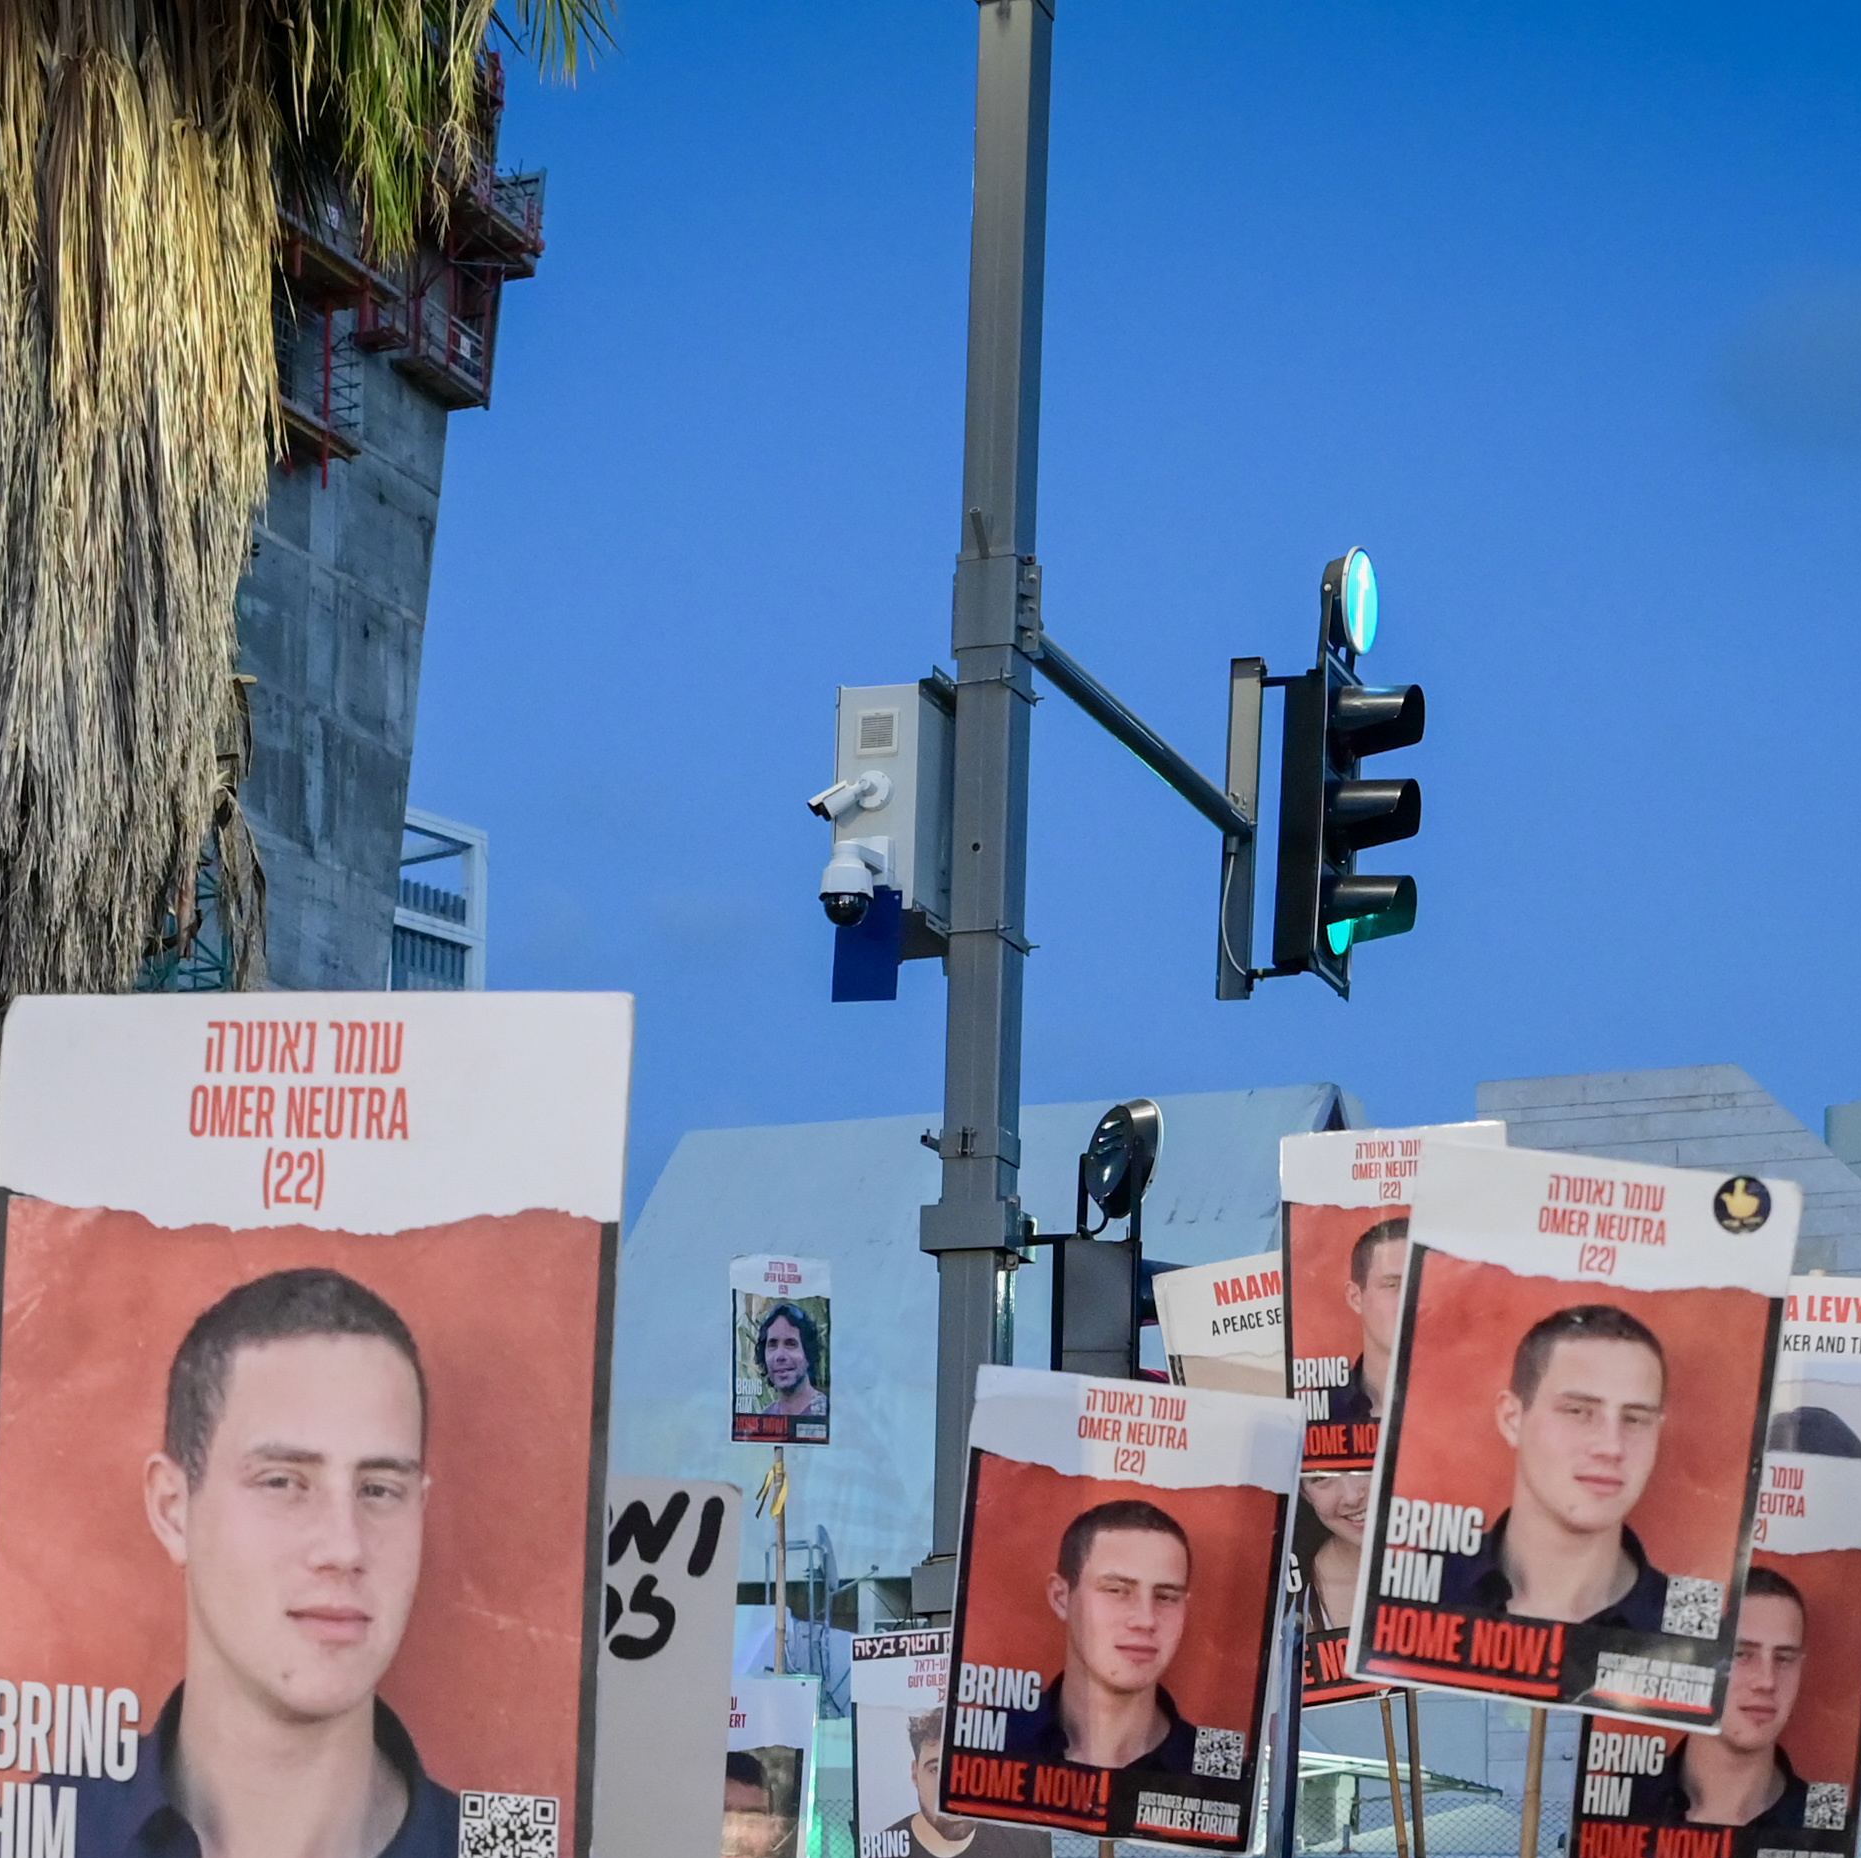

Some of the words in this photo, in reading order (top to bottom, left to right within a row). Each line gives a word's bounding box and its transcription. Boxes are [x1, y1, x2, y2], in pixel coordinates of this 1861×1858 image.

[204, 1020, 315, 1074] נאוטרה
[329, 1020, 403, 1074] עומר
[189, 1084, 273, 1138] OMER
[286, 1086, 409, 1140] NEUTRA
[263, 1148, 324, 1210] (22)
[1352, 1162, 1381, 1180] OMER
[1379, 1181, 1402, 1200] (22)
[1620, 1183, 1665, 1212] עומר
[1538, 1205, 1590, 1237] OMER
[1595, 1211, 1666, 1246] NEUTRA
[1578, 1243, 1616, 1274] (22)
[1225, 1310, 1263, 1333] PEACE
[1813, 1336, 1846, 1355] AND
[1292, 1357, 1349, 1387] BRING
[1149, 1389, 1186, 1421] עומר
[1078, 1420, 1122, 1443] OMER
[1127, 1422, 1188, 1451] NEUTRA
[1114, 1448, 1145, 1476] (22)
[1387, 1497, 1483, 1556] BRING
[1380, 1554, 1441, 1604] HIM
[853, 1637, 896, 1657] בעזה
[899, 1633, 938, 1656] חטוף
[1373, 1605, 1461, 1663] HOME
[1471, 1616, 1565, 1679] NOW!
[959, 1663, 1041, 1712] BRING
[1659, 1675, 1715, 1706] FORUM
[954, 1706, 1006, 1752] HIM
[1587, 1731, 1666, 1776] BRING
[949, 1754, 1026, 1802] HOME
[1035, 1764, 1109, 1816] NOW!
[1583, 1776, 1631, 1818] HIM
[1136, 1804, 1189, 1832] FAMILIES
[1192, 1809, 1239, 1837] FORUM
[860, 1830, 910, 1858] BRING
